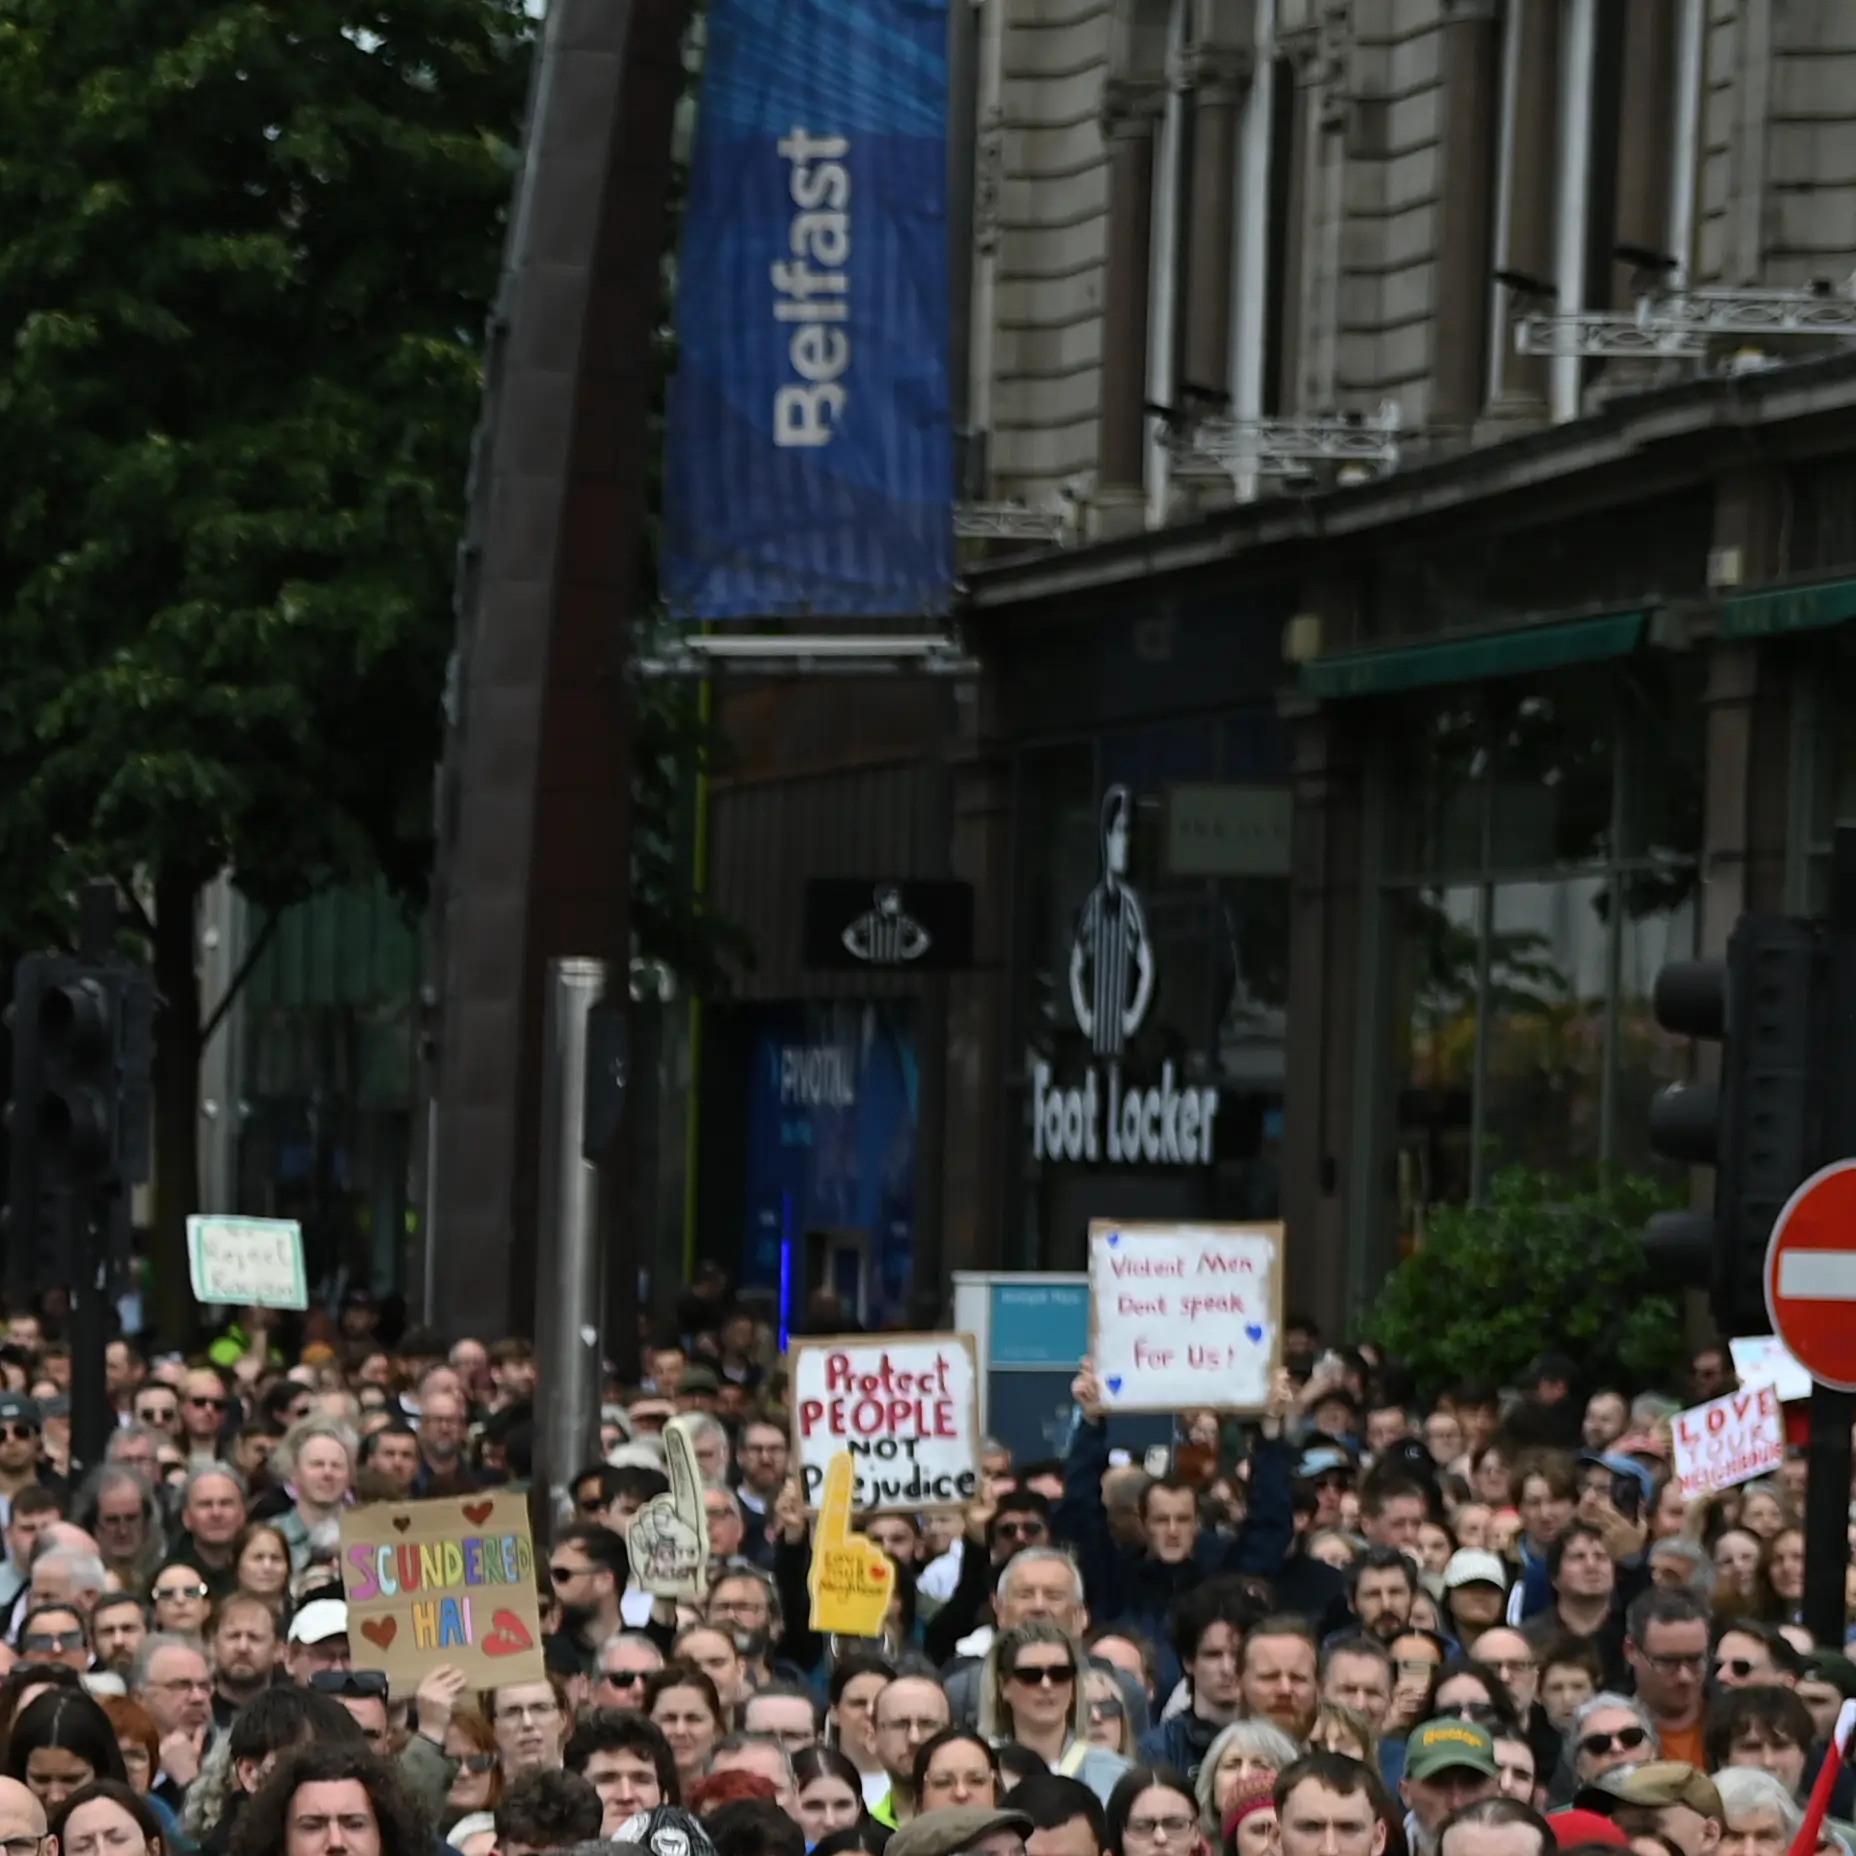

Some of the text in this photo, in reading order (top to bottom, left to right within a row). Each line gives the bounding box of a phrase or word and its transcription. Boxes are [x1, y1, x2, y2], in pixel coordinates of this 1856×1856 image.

[772, 127, 850, 447] Belfast
[1033, 1058, 1219, 1166] Foot Locker
[1111, 1252, 1253, 1279] Violent Men
[825, 1351, 951, 1400] Protect
[1134, 1338, 1174, 1370] For
[799, 1398, 958, 1439] PEOPLE
[1679, 1386, 1777, 1444] LOVE
[847, 1437, 921, 1461] NOT
[799, 1464, 978, 1511] Pejudice
[347, 1533, 532, 1602] SCUNDERED
[412, 1595, 474, 1652] HAI
